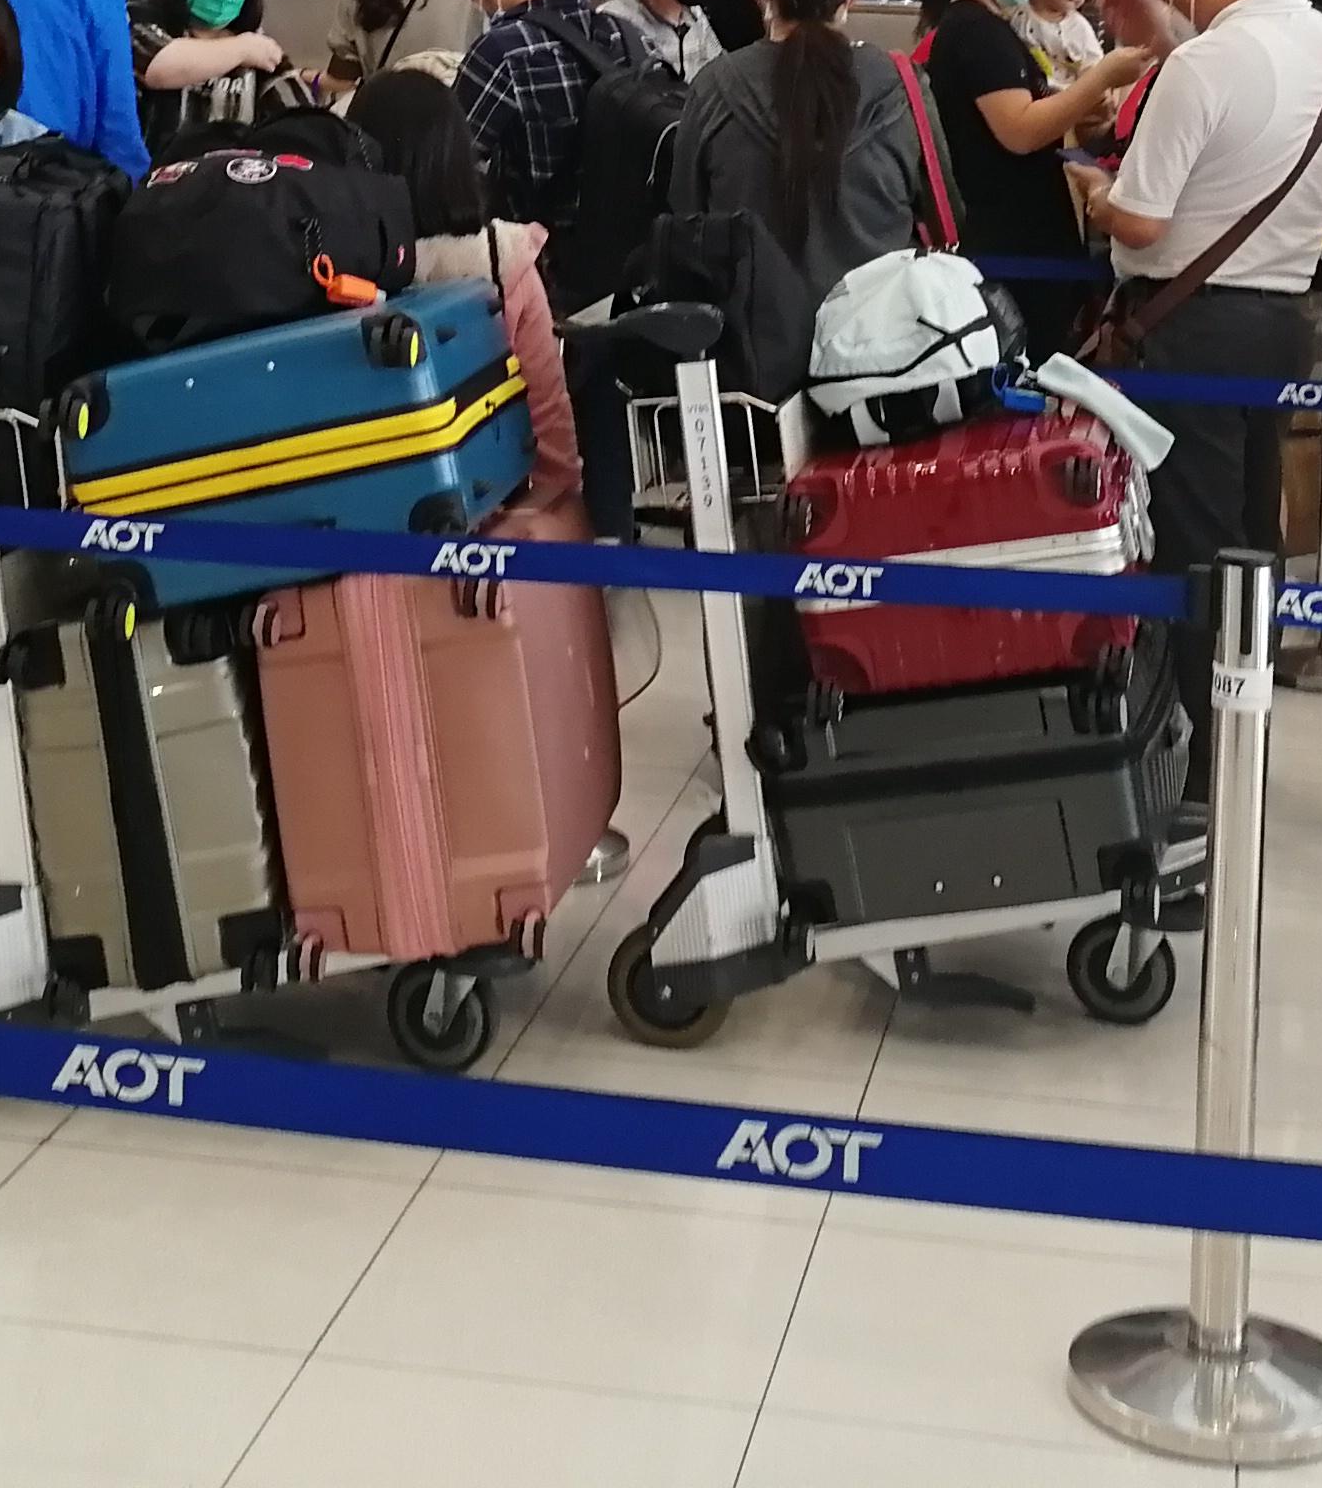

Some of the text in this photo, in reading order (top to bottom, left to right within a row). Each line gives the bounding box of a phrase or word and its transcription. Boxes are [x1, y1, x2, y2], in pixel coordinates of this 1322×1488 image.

[80, 519, 165, 552] AOT
[430, 542, 517, 576] AOT
[794, 562, 884, 597] AOT
[51, 1044, 206, 1106] AOT
[716, 1119, 883, 1183] AOT
